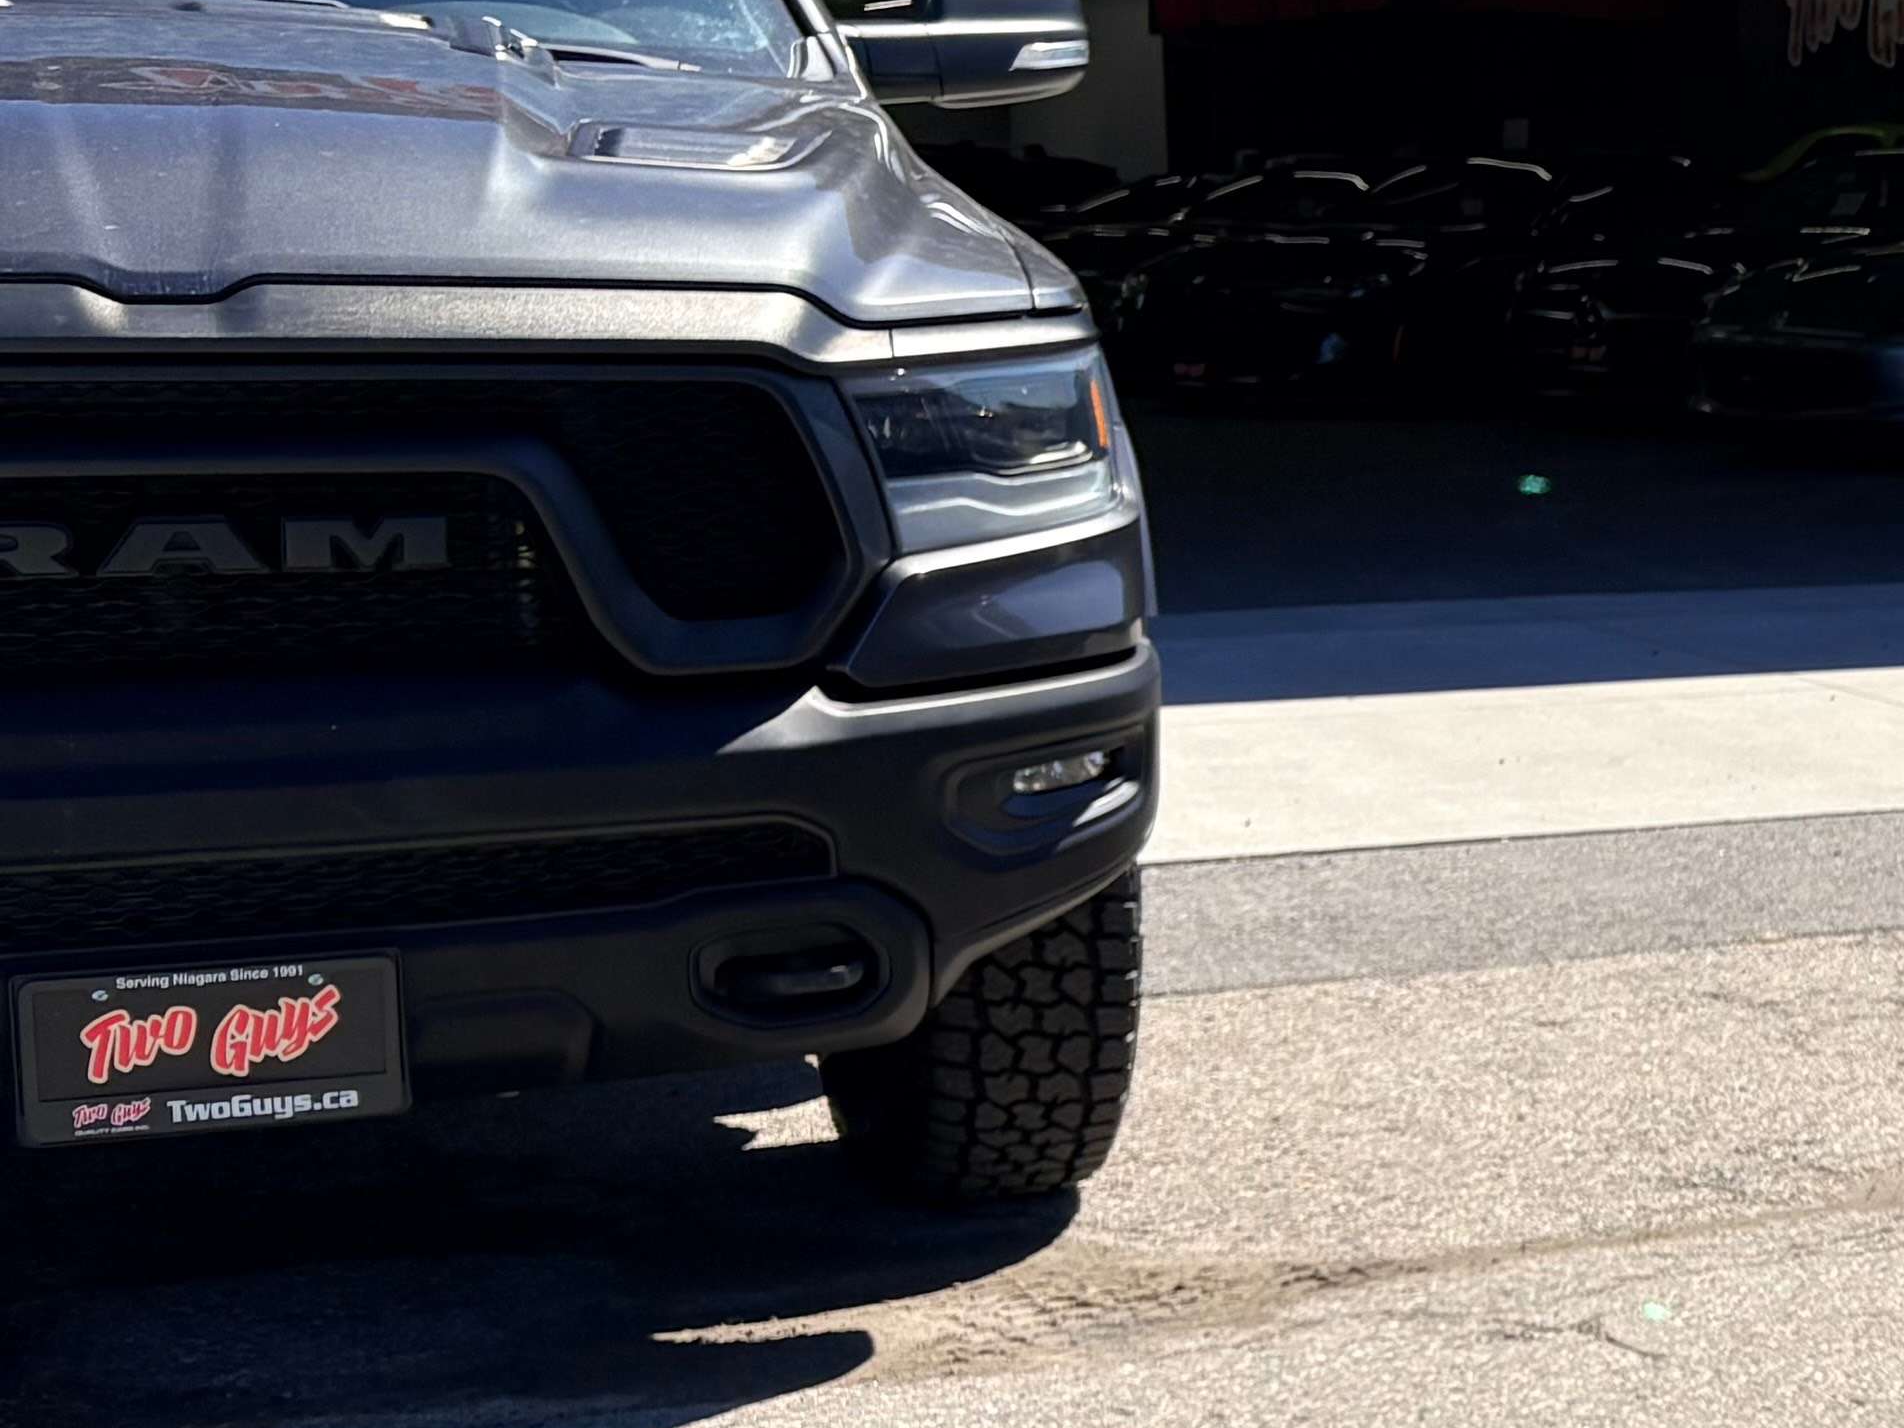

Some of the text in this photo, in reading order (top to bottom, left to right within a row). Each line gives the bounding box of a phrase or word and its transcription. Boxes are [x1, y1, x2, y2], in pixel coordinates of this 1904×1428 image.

[0, 516, 454, 579] RAM
[116, 976, 170, 990] Serving
[172, 973, 227, 987] Niagara
[230, 968, 269, 982] Since
[80, 984, 341, 1084] Two Guys
[166, 1089, 360, 1123] TwoGuys.ca
